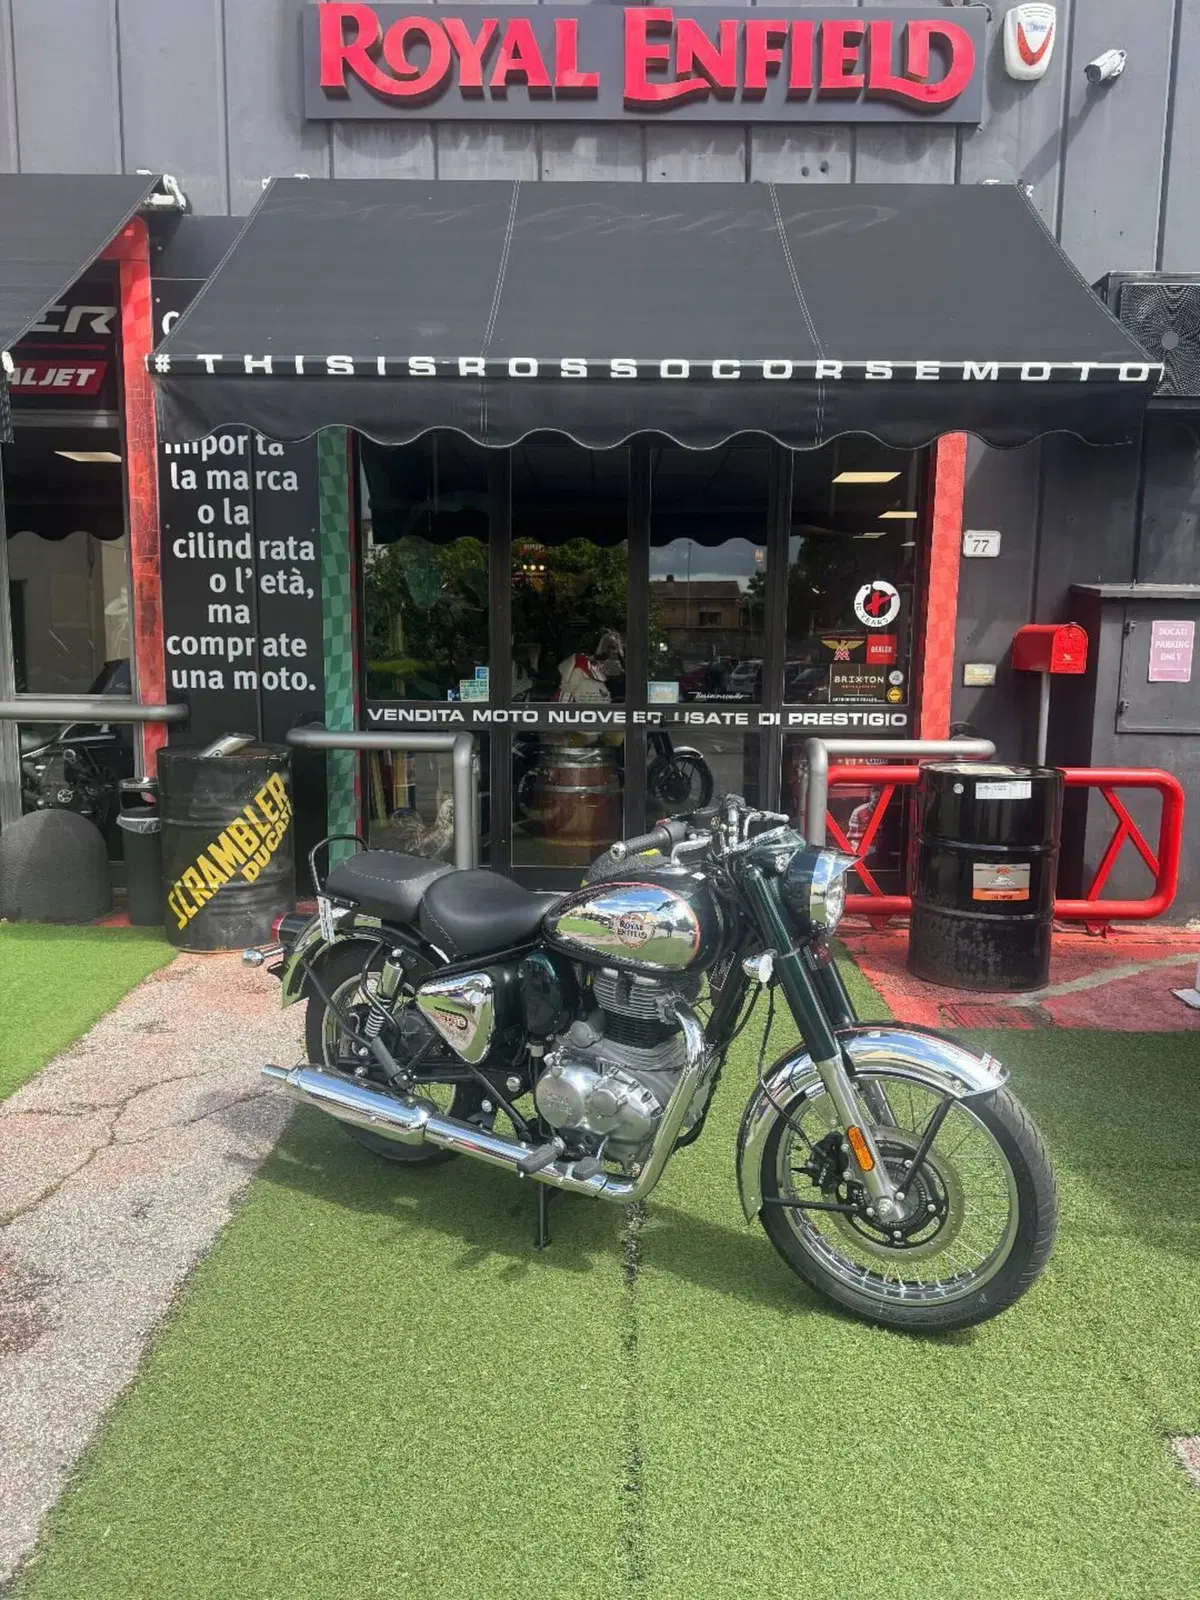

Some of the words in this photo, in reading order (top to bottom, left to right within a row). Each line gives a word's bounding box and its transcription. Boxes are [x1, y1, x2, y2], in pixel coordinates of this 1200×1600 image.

[319, 2, 599, 99] ROYAL
[624, 7, 976, 104] ENFIELD
[170, 462, 198, 490] la
[206, 469, 299, 492] marca
[197, 504, 215, 525] o
[223, 497, 250, 525] la
[172, 531, 316, 562] cilindrata
[973, 539, 989, 553] 77
[209, 573, 227, 593] o
[208, 603, 251, 624] ma
[1159, 627, 1188, 637] DUCATI
[166, 633, 307, 663] comprate
[1155, 640, 1190, 649] PARKING
[1160, 652, 1183, 661] ONLY
[172, 669, 225, 689] una
[233, 667, 317, 691] moto.
[834, 676, 885, 684] BRIXTON
[367, 708, 465, 723] VENDITA
[472, 710, 540, 723] MOTO
[548, 711, 626, 724] NUOVE
[758, 713, 780, 726] DI
[788, 713, 908, 727] PRESTIGIO
[168, 772, 291, 931] SCRAMBLER
[619, 920, 644, 931] ROYAL
